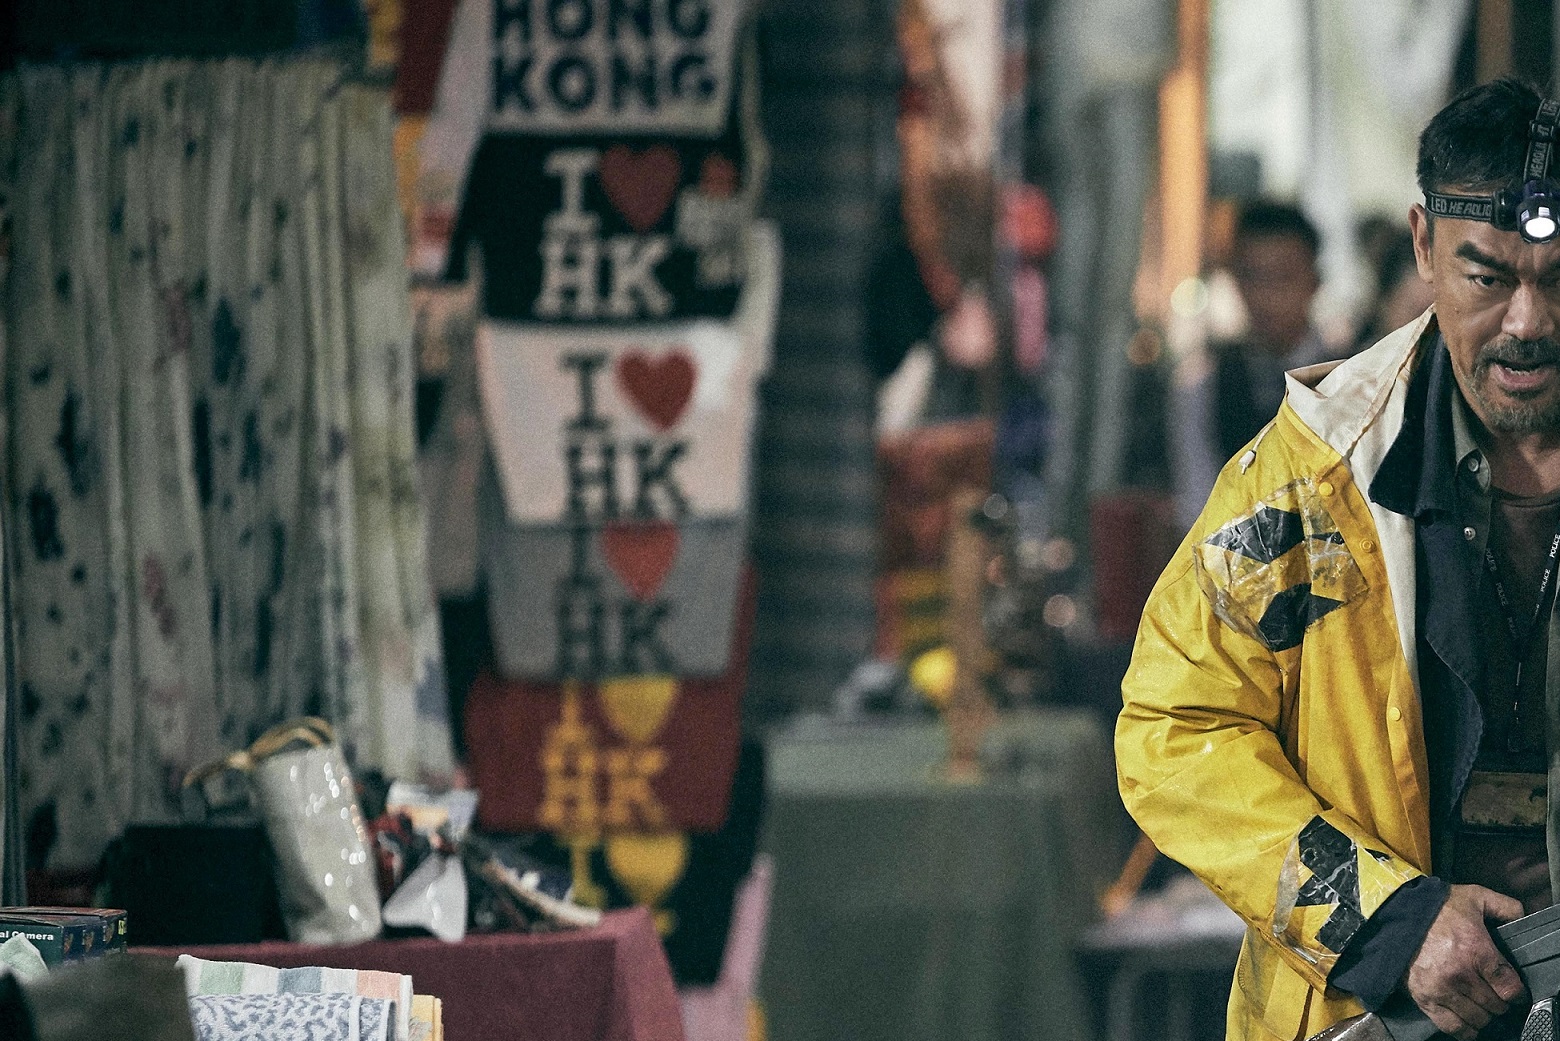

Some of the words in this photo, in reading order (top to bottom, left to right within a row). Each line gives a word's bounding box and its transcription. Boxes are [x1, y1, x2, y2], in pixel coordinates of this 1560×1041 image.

[492, 54, 718, 113] KONG
[535, 233, 674, 317] HK
[559, 352, 612, 431] I
[563, 440, 690, 522] HK
[1540, 568, 1551, 592] POLICE
[1549, 533, 1560, 558] POLICE
[553, 600, 677, 680] HK
